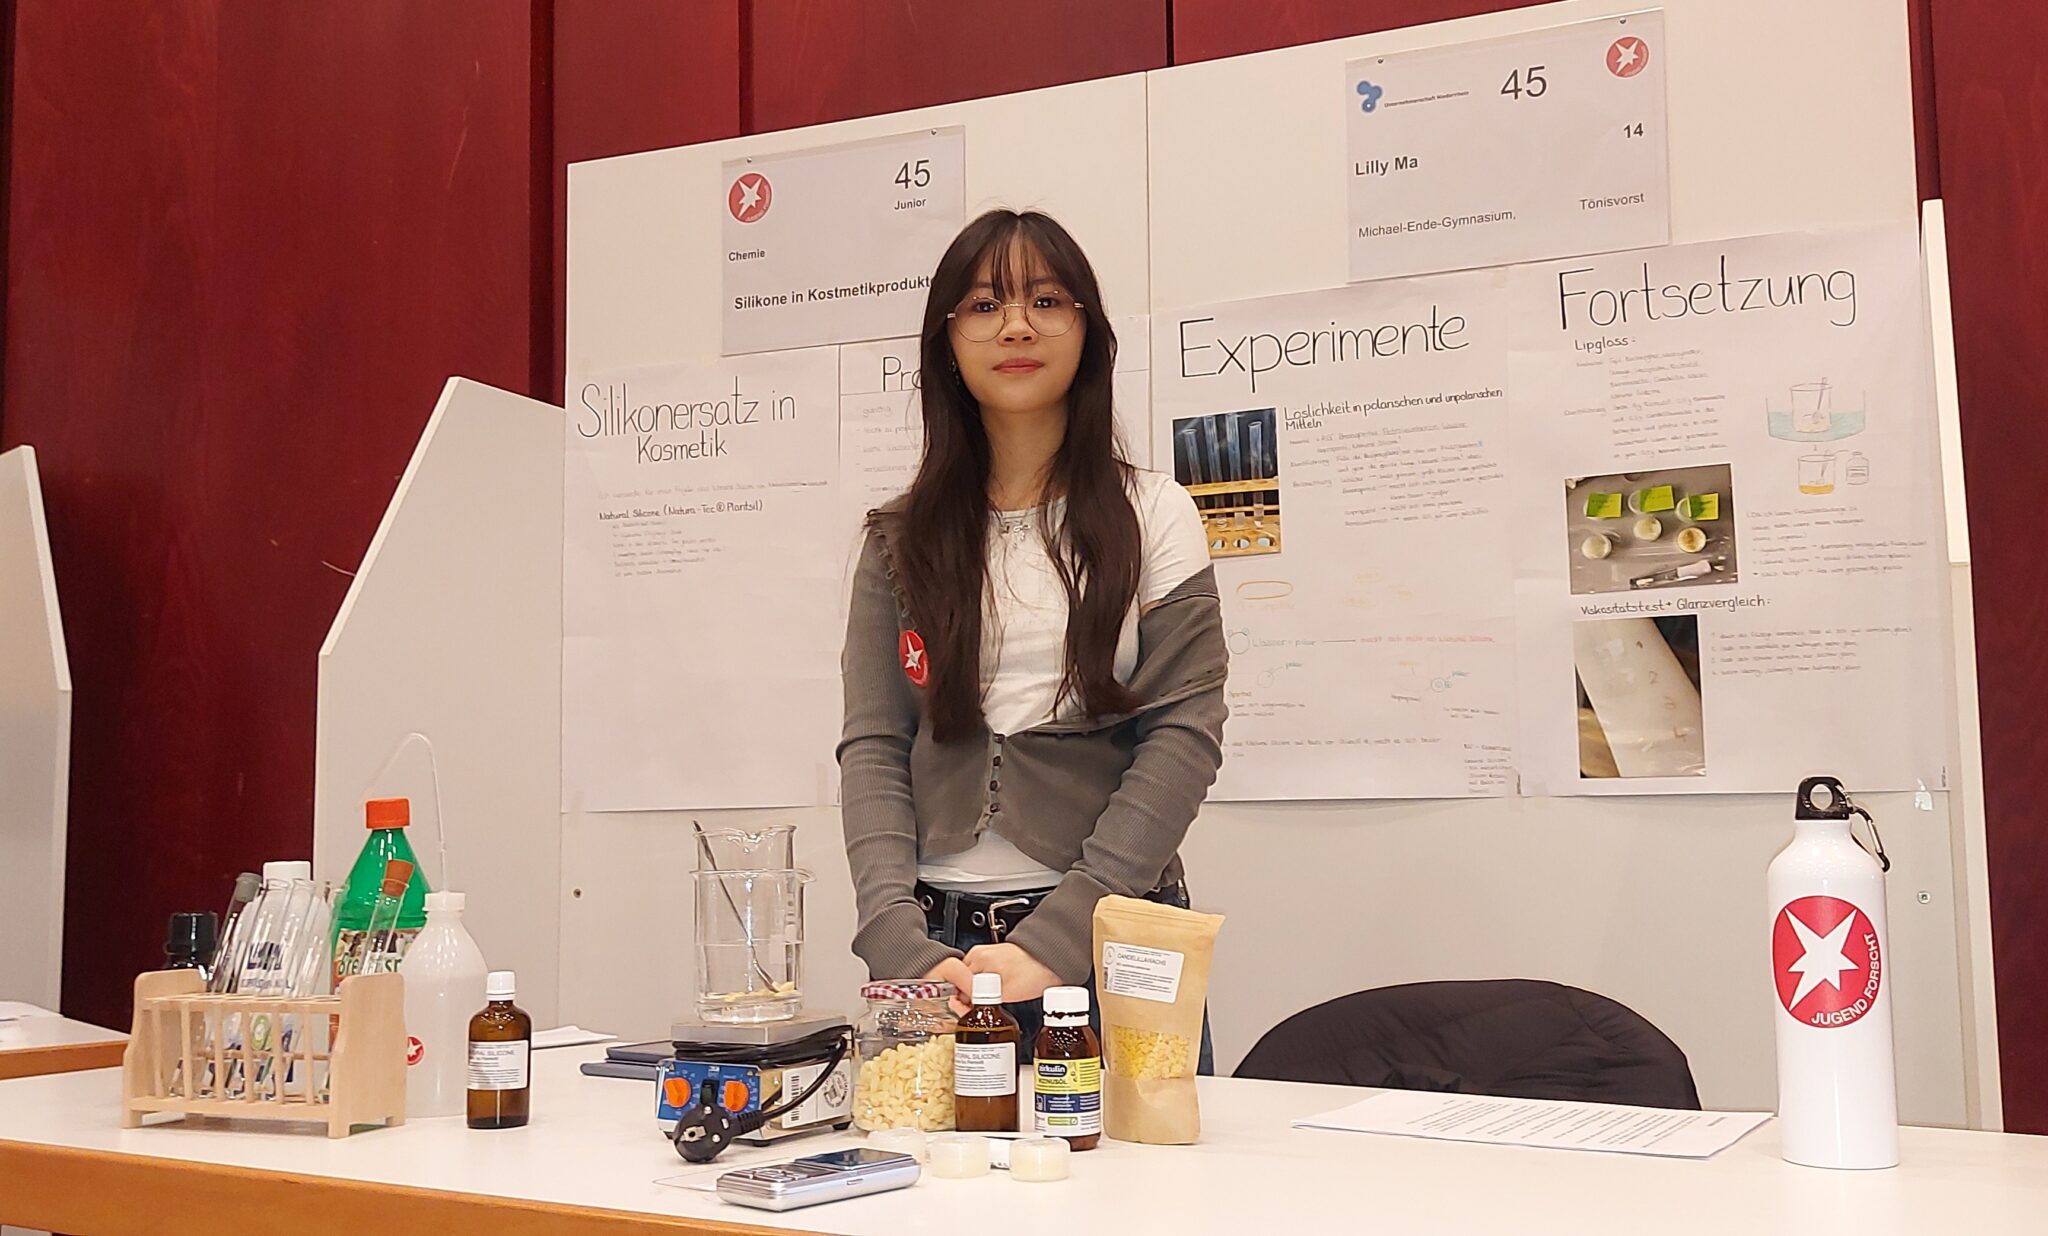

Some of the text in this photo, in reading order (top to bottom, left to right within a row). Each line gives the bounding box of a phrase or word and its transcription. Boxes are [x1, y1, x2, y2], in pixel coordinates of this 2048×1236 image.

[1500, 66, 1547, 100] 45
[1623, 123, 1644, 138] 14
[894, 159, 931, 189] 45
[1355, 156, 1418, 176] Lilly Ma
[894, 198, 926, 211] Junior
[1579, 193, 1644, 211] Tönisvorst
[1358, 210, 1516, 238] Michael-Ende-Gymnasium,
[728, 249, 765, 262] Chemie
[735, 275, 931, 310] Silikone in Kostmetikprodukt
[1558, 254, 1857, 330] Fortsetzung
[1179, 305, 1470, 393] Experimente
[577, 376, 796, 437] Silikonersatz in
[1425, 393, 1442, 404] und
[1286, 418, 1322, 431] Mitteln
[637, 428, 728, 464] Kosmetik
[599, 508, 629, 520] Natural
[1811, 933, 1880, 1025] JUGEND FORSCHT
